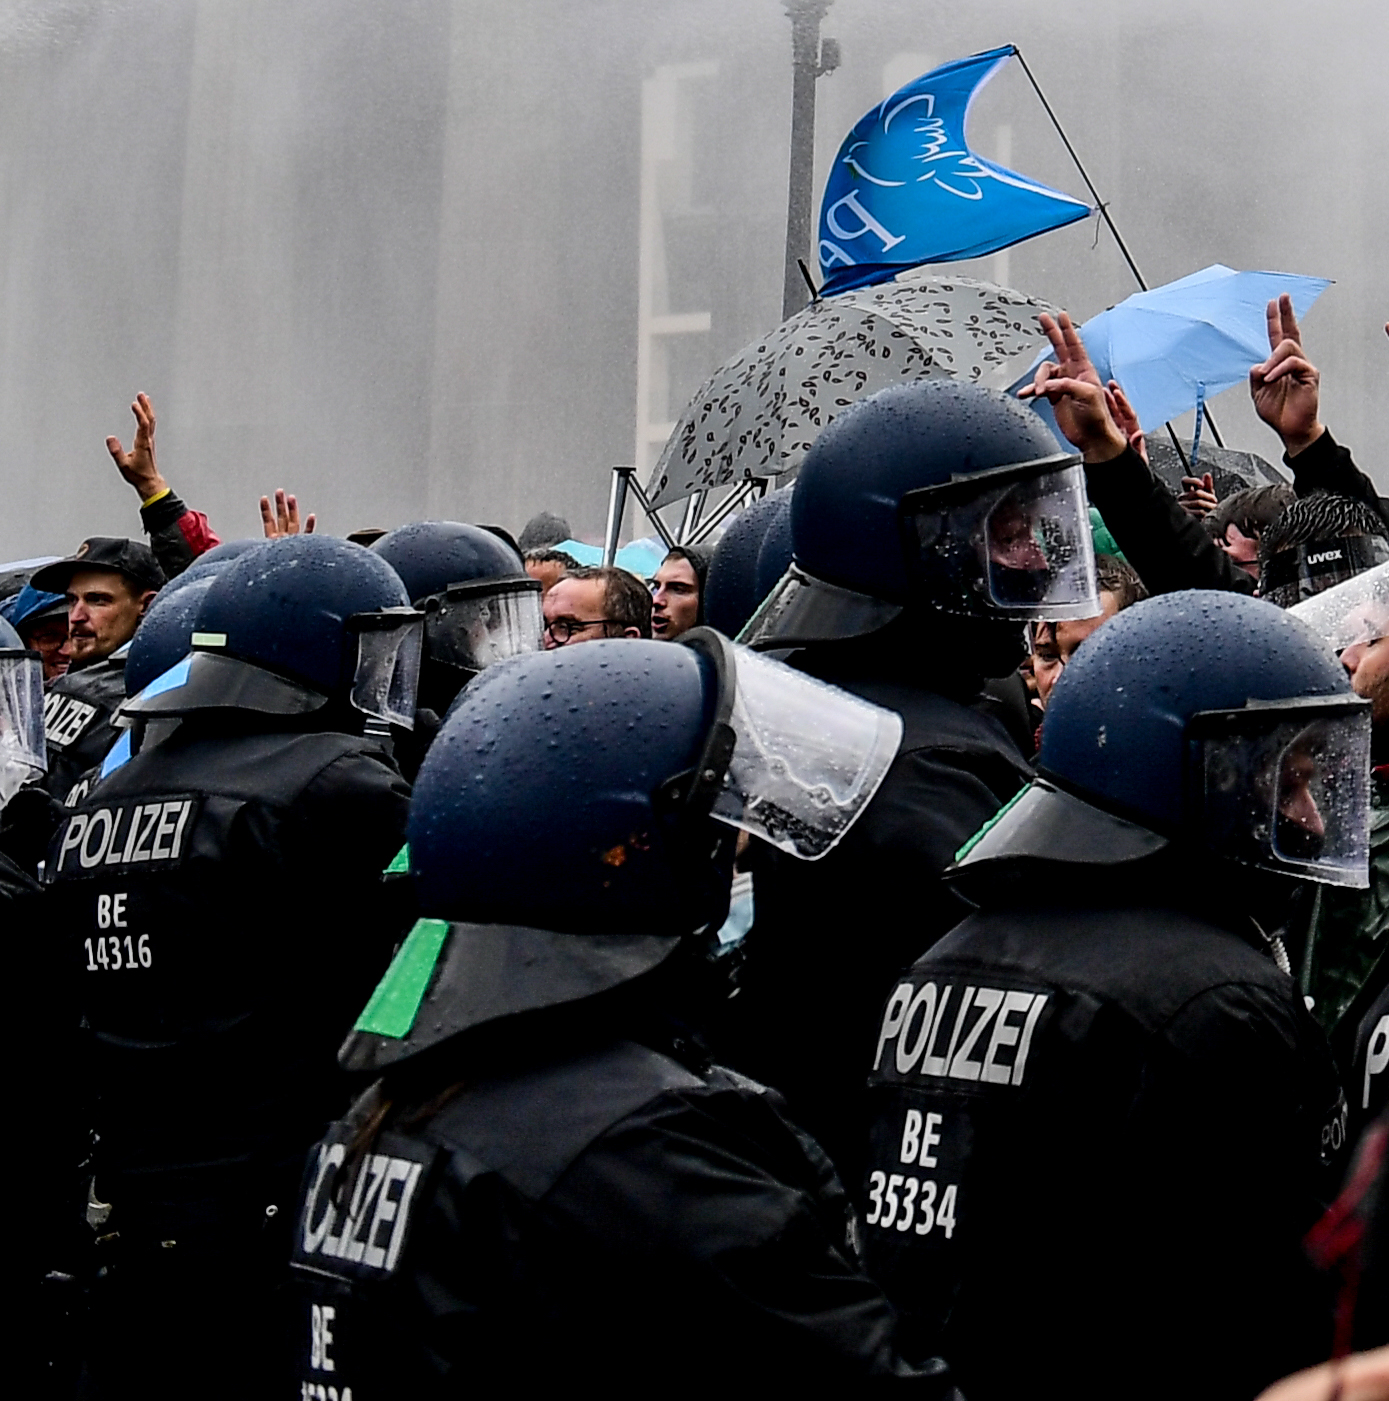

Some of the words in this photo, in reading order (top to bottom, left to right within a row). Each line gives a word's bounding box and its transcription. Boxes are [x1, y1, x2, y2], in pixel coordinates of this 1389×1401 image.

[1307, 549, 1342, 565] uvex
[44, 692, 98, 746] OLIZEI
[58, 800, 192, 872] POLIZEI
[97, 893, 128, 928] BE
[84, 933, 152, 971] 14316
[872, 982, 1048, 1086] POLIZEI
[900, 1109, 943, 1168] BE
[866, 1171, 958, 1239] 35334
[311, 1304, 336, 1372] BE
